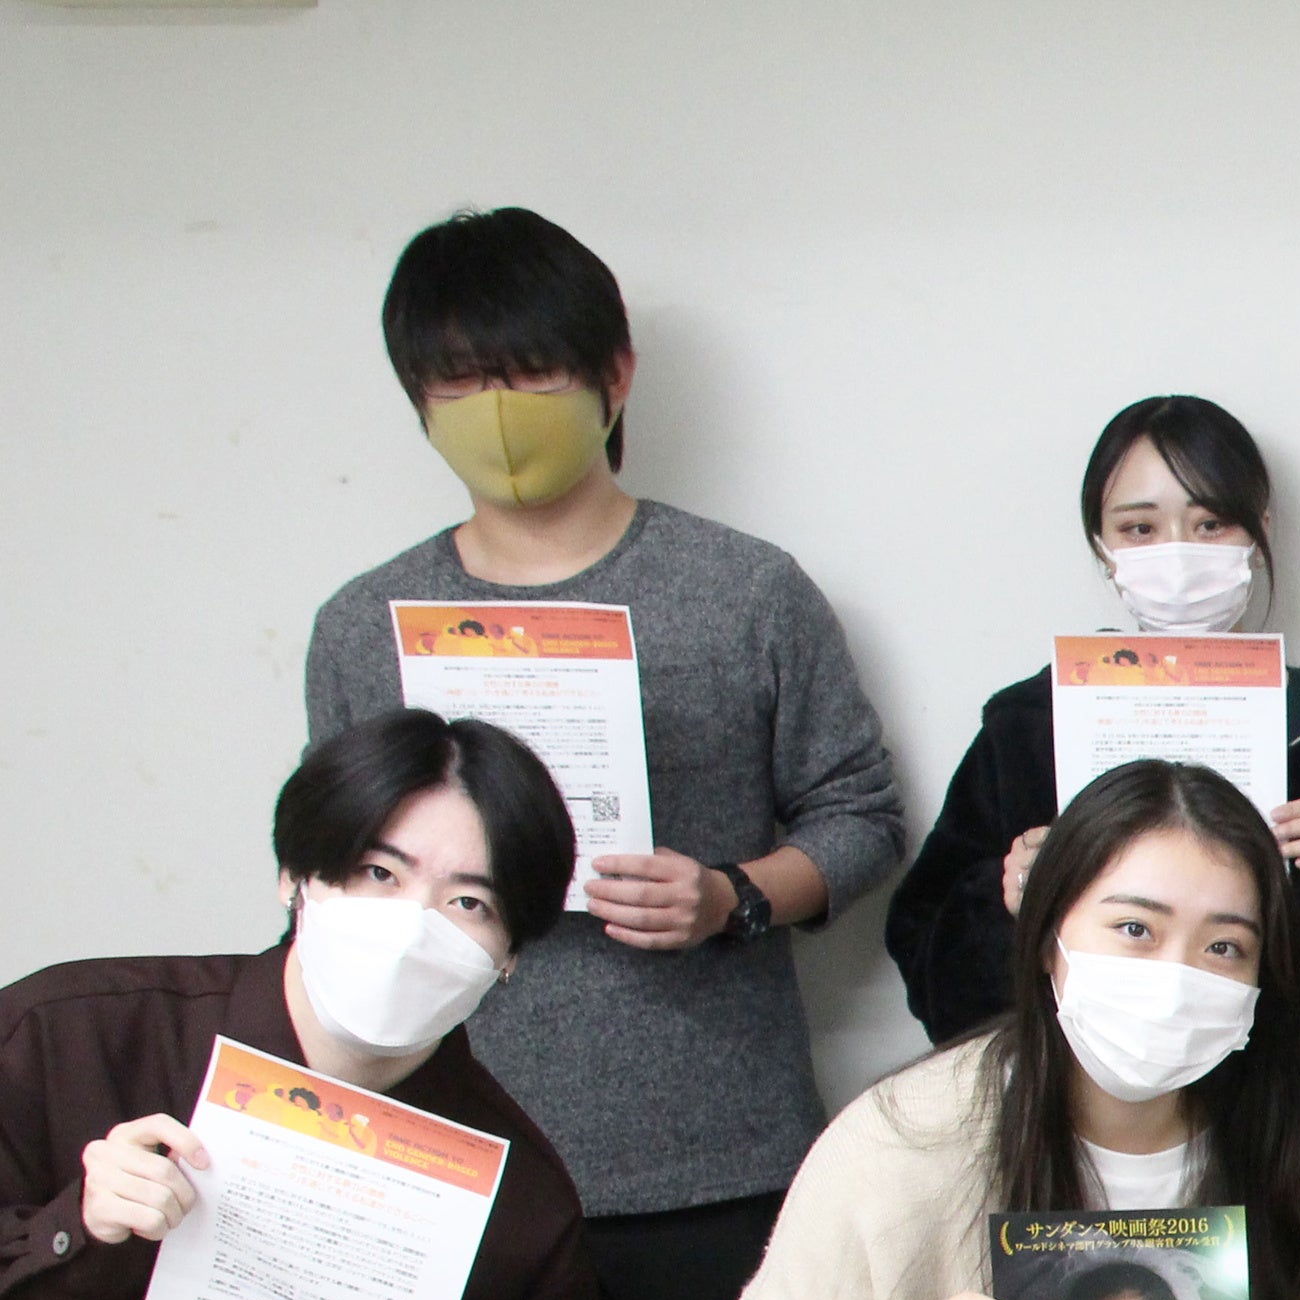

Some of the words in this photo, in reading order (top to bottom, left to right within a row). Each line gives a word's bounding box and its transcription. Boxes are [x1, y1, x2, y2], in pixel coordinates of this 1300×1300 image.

[1025, 1216, 1210, 1240] サンダンス映画祭2016
